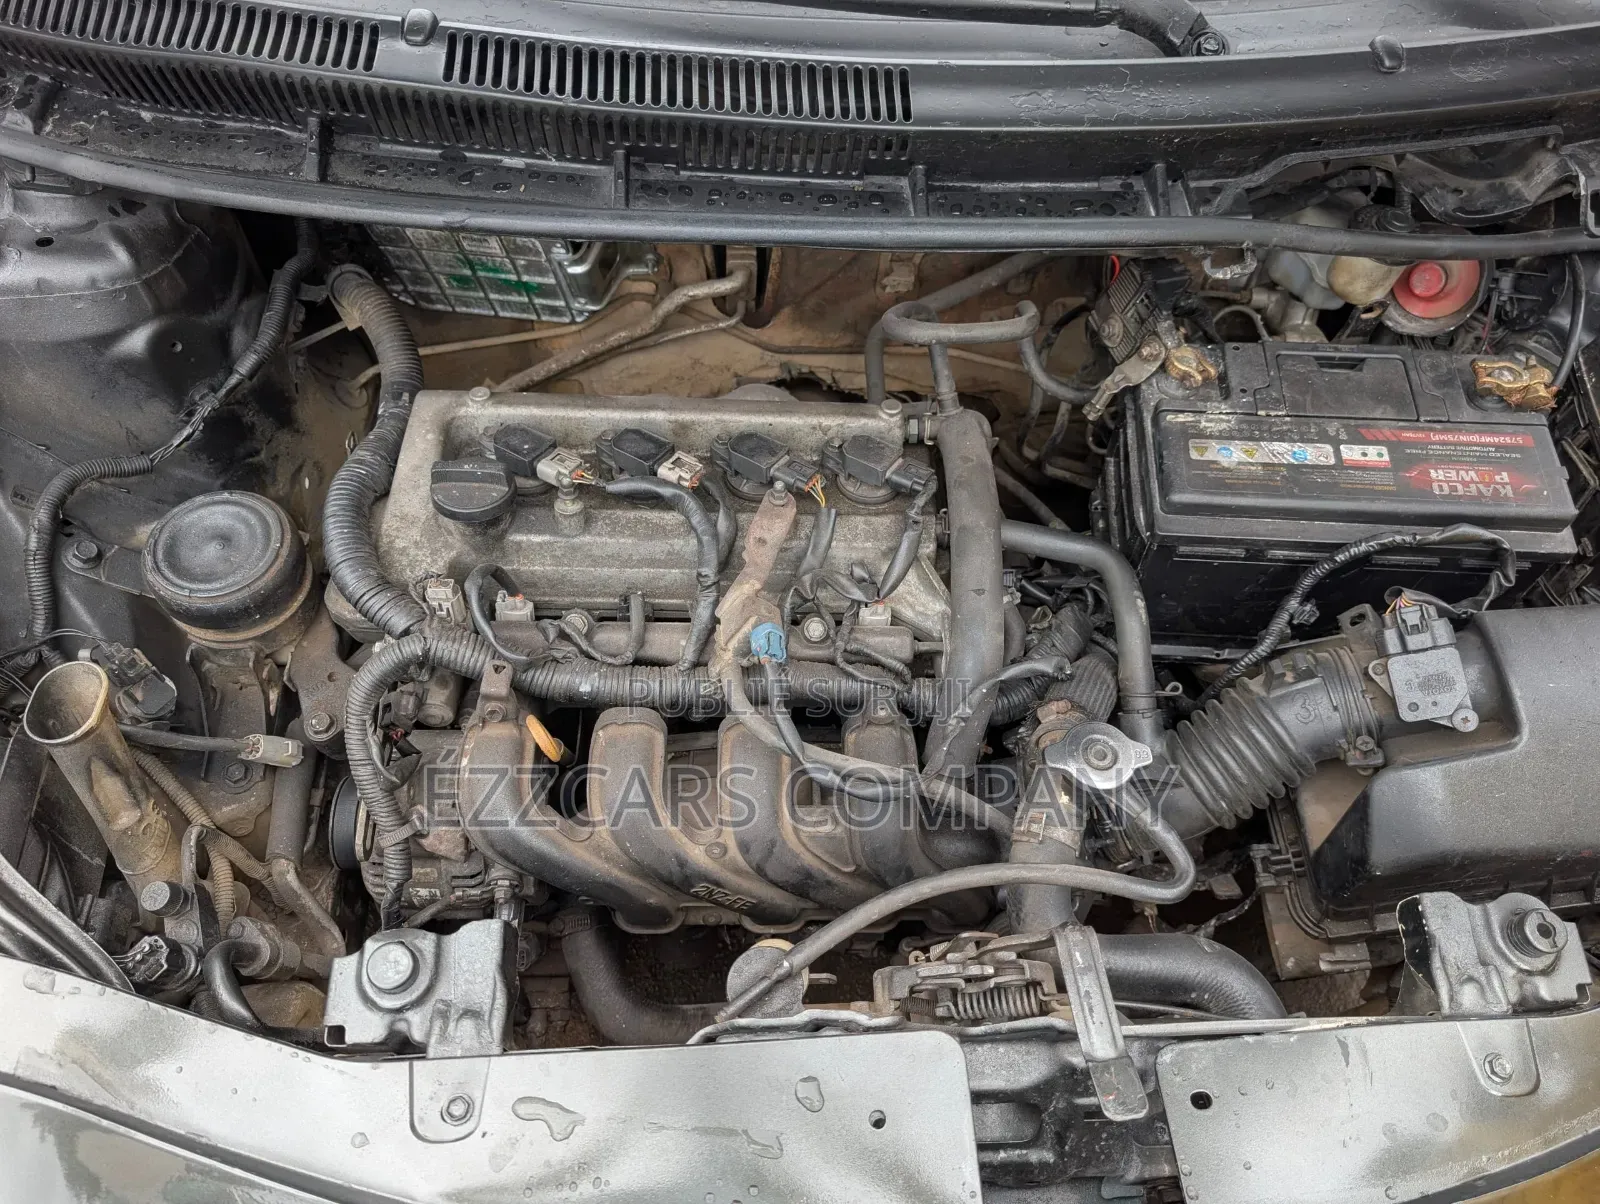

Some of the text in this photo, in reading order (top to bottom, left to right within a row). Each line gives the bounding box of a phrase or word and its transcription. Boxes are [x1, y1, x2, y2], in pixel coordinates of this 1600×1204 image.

[1427, 449, 1487, 458] MAINTENANCE
[1488, 451, 1522, 459] SEALED
[1431, 481, 1515, 498] KAFCO
